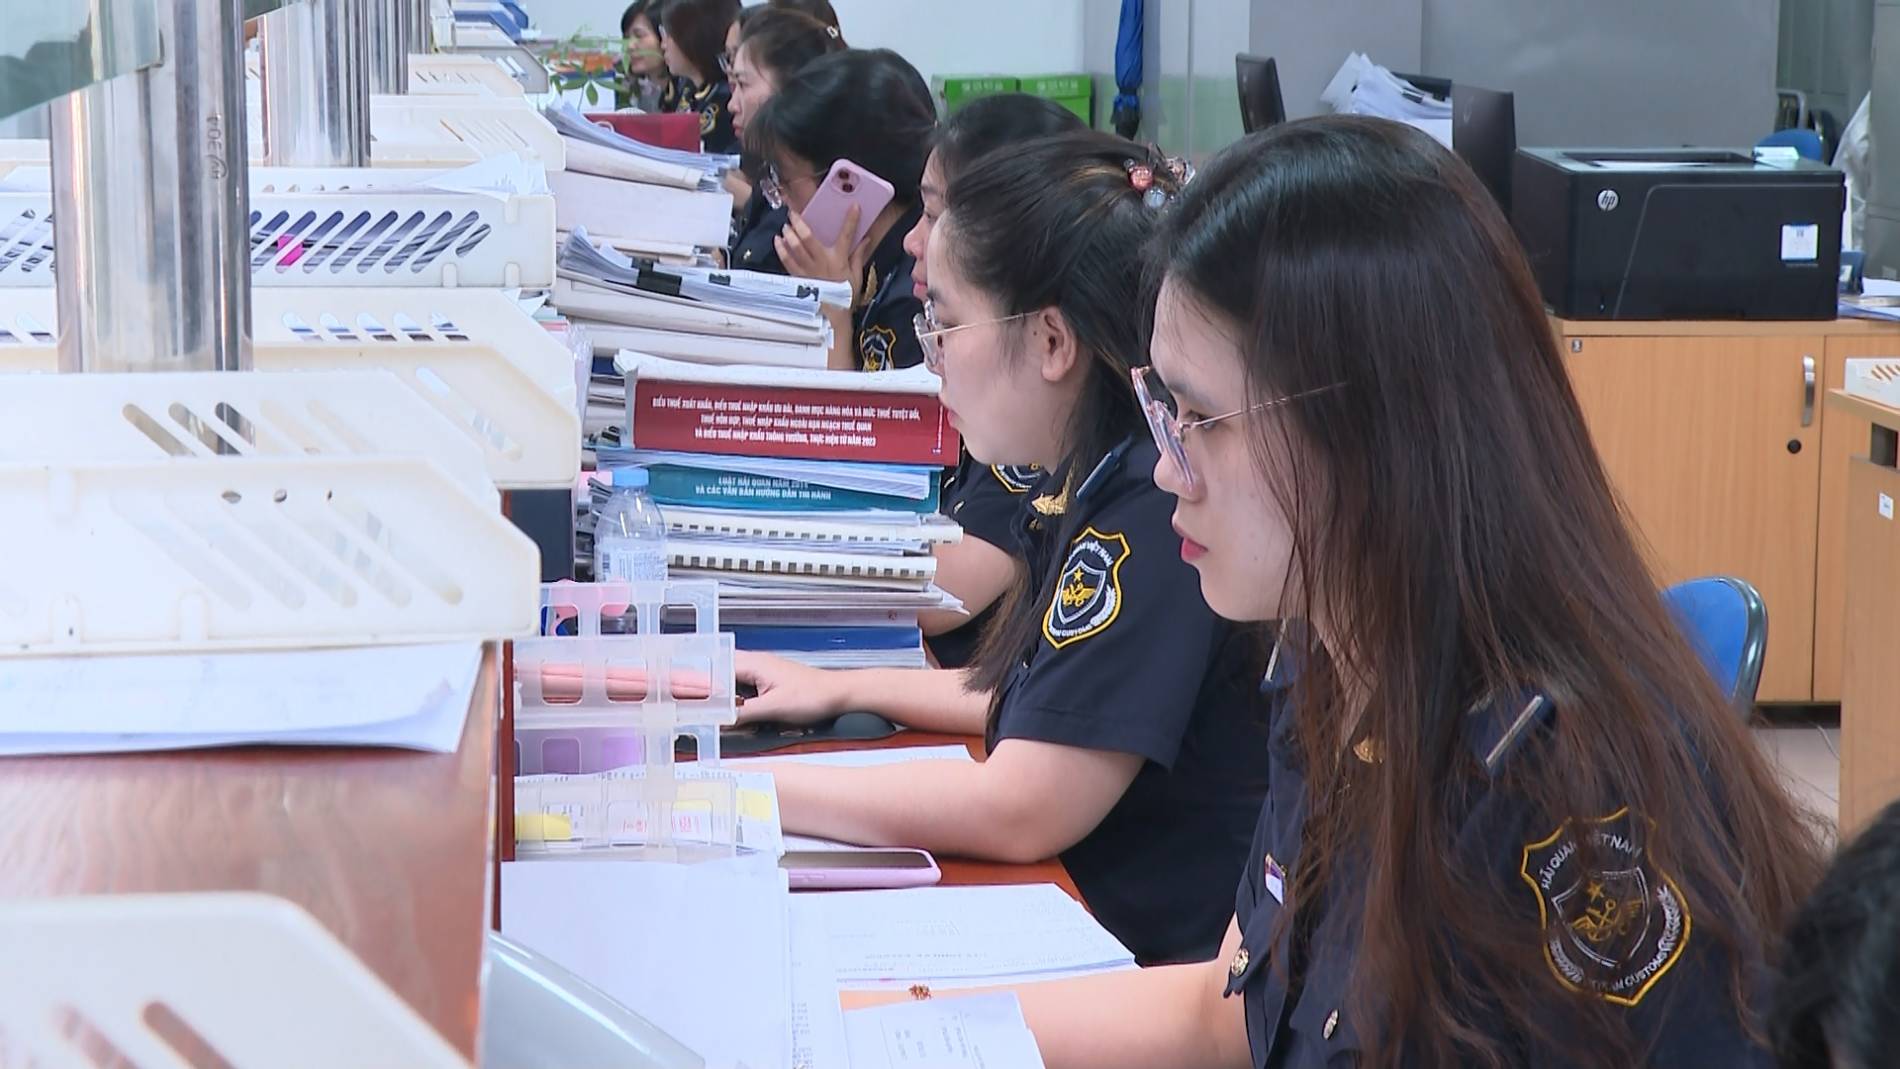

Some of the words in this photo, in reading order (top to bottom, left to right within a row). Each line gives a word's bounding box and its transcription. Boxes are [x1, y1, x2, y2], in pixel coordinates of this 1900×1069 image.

[1600, 190, 1616, 211] hp
[652, 394, 666, 408] BIỂU
[667, 396, 681, 409] THUẾ
[682, 396, 696, 409] XUẤT
[714, 398, 727, 411] BIỂU
[728, 400, 741, 412] THUẾ
[742, 400, 758, 414] NHẬP
[758, 400, 773, 413] KHẨU
[795, 404, 811, 415] DANH
[811, 405, 824, 417] MỤC
[825, 404, 841, 416] HÀNG
[854, 406, 862, 417] VÀ
[863, 406, 876, 418] MỨC
[877, 406, 891, 419] THUẾ
[892, 408, 908, 420] TUYỆT
[701, 412, 715, 425] THUẾ
[742, 414, 756, 427] THUẾ
[757, 416, 773, 429] NHẬP
[774, 415, 789, 428] KHẨU
[842, 420, 855, 432] THUẾ
[856, 421, 872, 433] QUAN
[694, 426, 703, 439] VÀ
[703, 426, 717, 439] BIỂU
[718, 428, 732, 440] THUẾ
[732, 429, 748, 442] NHẬP
[749, 427, 765, 441] KHẨU
[765, 430, 784, 443] THÔNG
[810, 433, 824, 446] THỰC
[825, 433, 839, 447] HIỆN
[839, 434, 847, 446] TỪ
[847, 434, 861, 447] NĂM
[861, 437, 876, 448] 2023
[718, 475, 736, 486] LUẬT
[737, 475, 750, 486] HẢI
[751, 477, 771, 487] QUAN
[695, 483, 705, 495] VÀ
[706, 484, 722, 495] CÁC
[722, 485, 737, 497] VĂN
[738, 485, 754, 497] BẢN
[755, 486, 781, 499] HƯỚNG
[781, 487, 797, 499] DẪN
[798, 489, 810, 499] THI
[811, 489, 832, 501] HÀNH
[1061, 623, 1093, 637] CUSTOMS
[1540, 864, 1556, 891] HẢI
[1625, 951, 1668, 987] CUSTOMS
